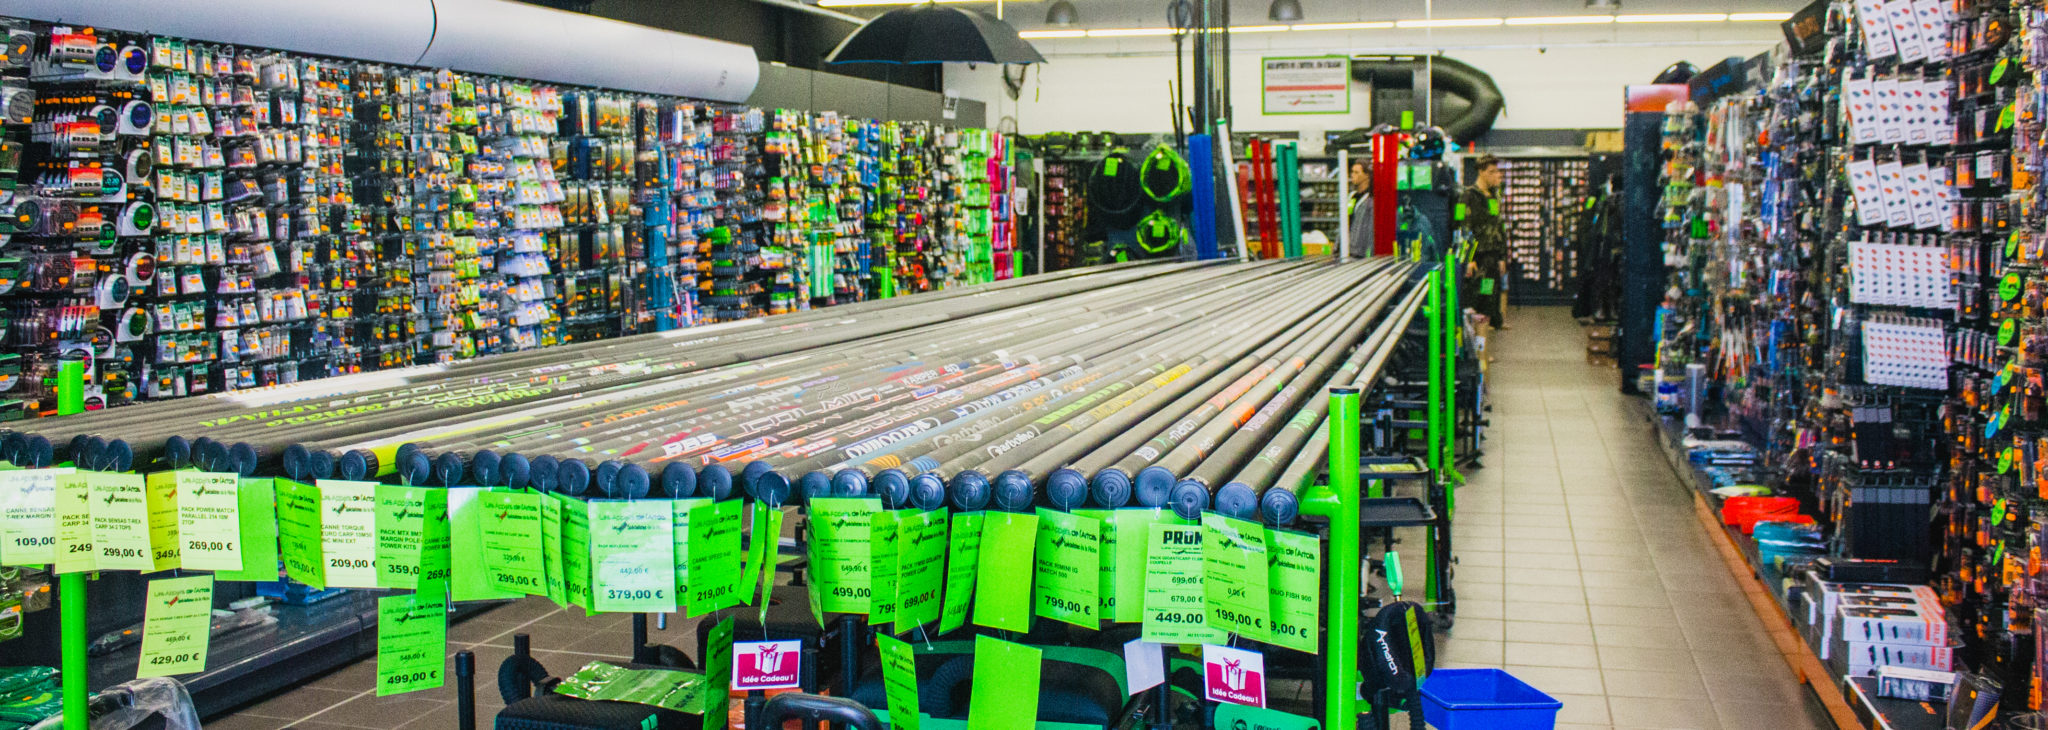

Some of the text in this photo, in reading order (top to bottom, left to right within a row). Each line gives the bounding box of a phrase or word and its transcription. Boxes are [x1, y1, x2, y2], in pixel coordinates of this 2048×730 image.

[15, 537, 56, 547] 109,00
[69, 543, 93, 553] 249
[189, 540, 233, 551] 269,00 €
[104, 548, 143, 558] 299,00 €
[330, 558, 368, 569] 209,00
[901, 562, 913, 571] PACK
[1038, 559, 1053, 568] PACK
[901, 569, 917, 579] POWER
[1038, 566, 1057, 576] MATCH
[497, 573, 538, 586] 299,00 €
[1171, 576, 1197, 584] 699,00
[608, 589, 664, 601] 379,00 €
[697, 583, 734, 602] 219,00 €
[832, 586, 871, 599] 499,00
[904, 588, 936, 609] 699,00 €
[1270, 588, 1284, 597] DUO
[1286, 591, 1300, 600] FISH
[1171, 595, 1196, 603] 679,00
[1045, 595, 1091, 616] 799,00 €
[1155, 612, 1203, 624] 449.00
[1215, 608, 1262, 629] 199,00 €
[1299, 627, 1308, 640] €
[151, 652, 199, 665] 429,00 €
[387, 670, 437, 684] 499,00 €
[742, 675, 759, 683] Idée
[760, 674, 789, 683] Cadeau
[1212, 687, 1227, 697] Idée
[1228, 691, 1254, 702] Cadeau
